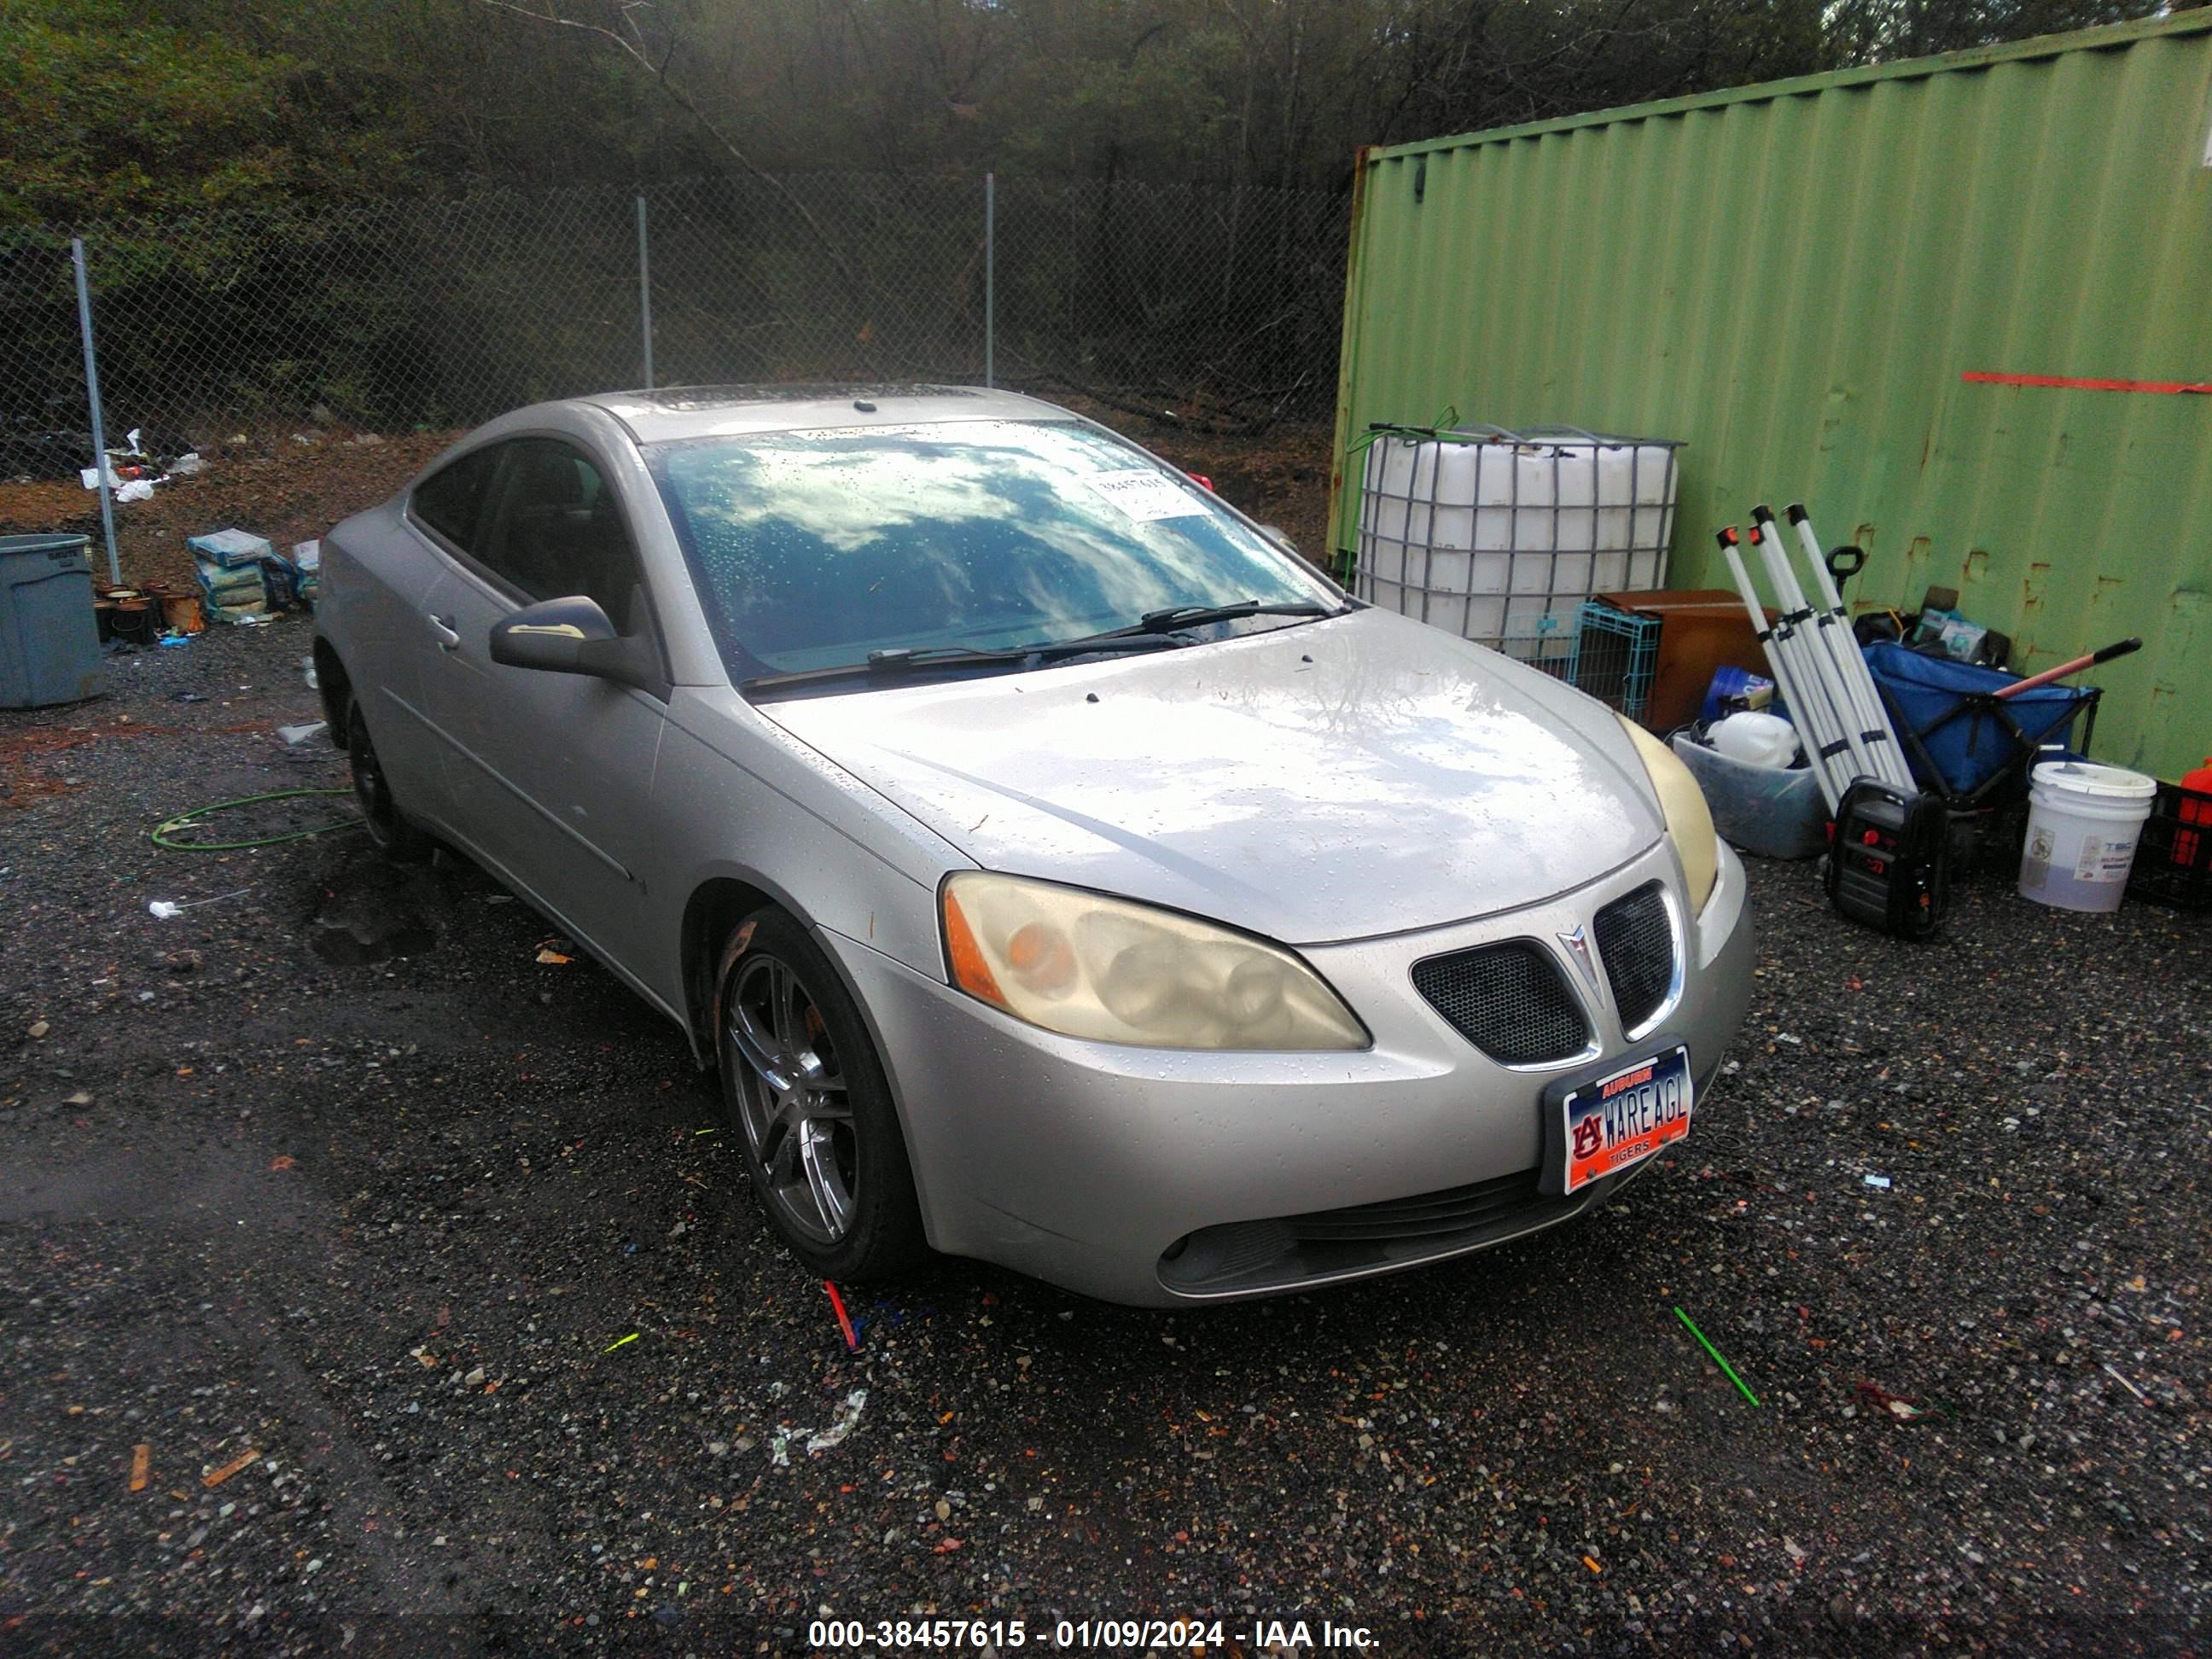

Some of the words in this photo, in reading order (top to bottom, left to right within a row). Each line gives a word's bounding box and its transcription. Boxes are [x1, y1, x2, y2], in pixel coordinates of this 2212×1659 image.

[1603, 1067, 1652, 1099] AUBURN
[1604, 1074, 1687, 1150] WAREAGL
[1610, 1140, 1650, 1164] TIGERS
